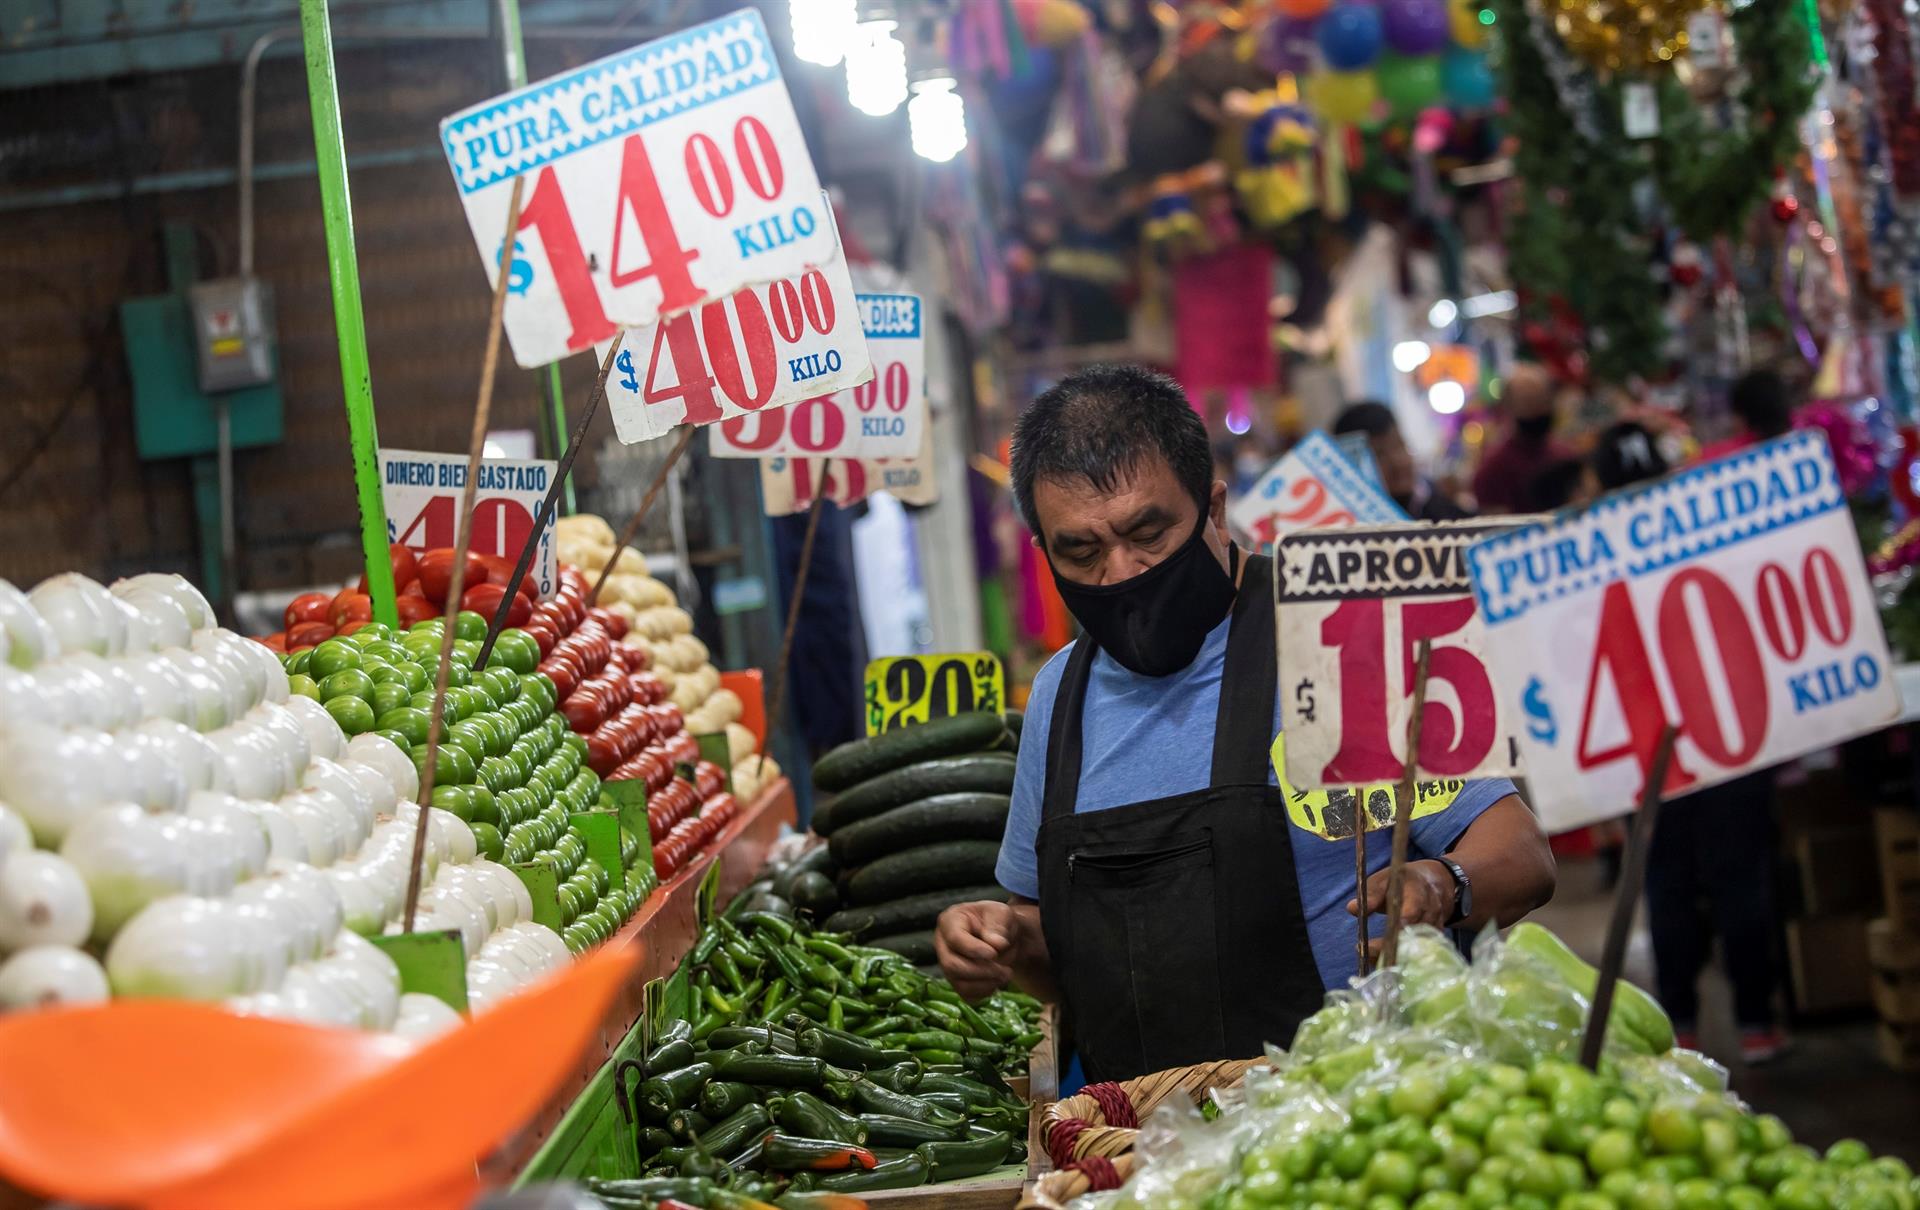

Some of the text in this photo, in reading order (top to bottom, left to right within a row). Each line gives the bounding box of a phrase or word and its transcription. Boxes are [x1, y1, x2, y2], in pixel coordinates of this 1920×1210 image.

[466, 38, 755, 169] PURA CALIDAD
[516, 134, 707, 352] 14
[684, 116, 785, 218] 00
[733, 206, 817, 259] KILO
[871, 305, 900, 325] DIA
[616, 270, 836, 425] $ 40 00
[788, 349, 842, 382] KILO
[861, 417, 905, 437] KILO
[386, 462, 434, 485] DINERO
[478, 466, 546, 491] GASTADO
[1495, 457, 1822, 596] PURA CALIDAD
[541, 533, 551, 595] KILO
[1521, 545, 1854, 806] $ 40 00
[1788, 652, 1881, 714] KILO
